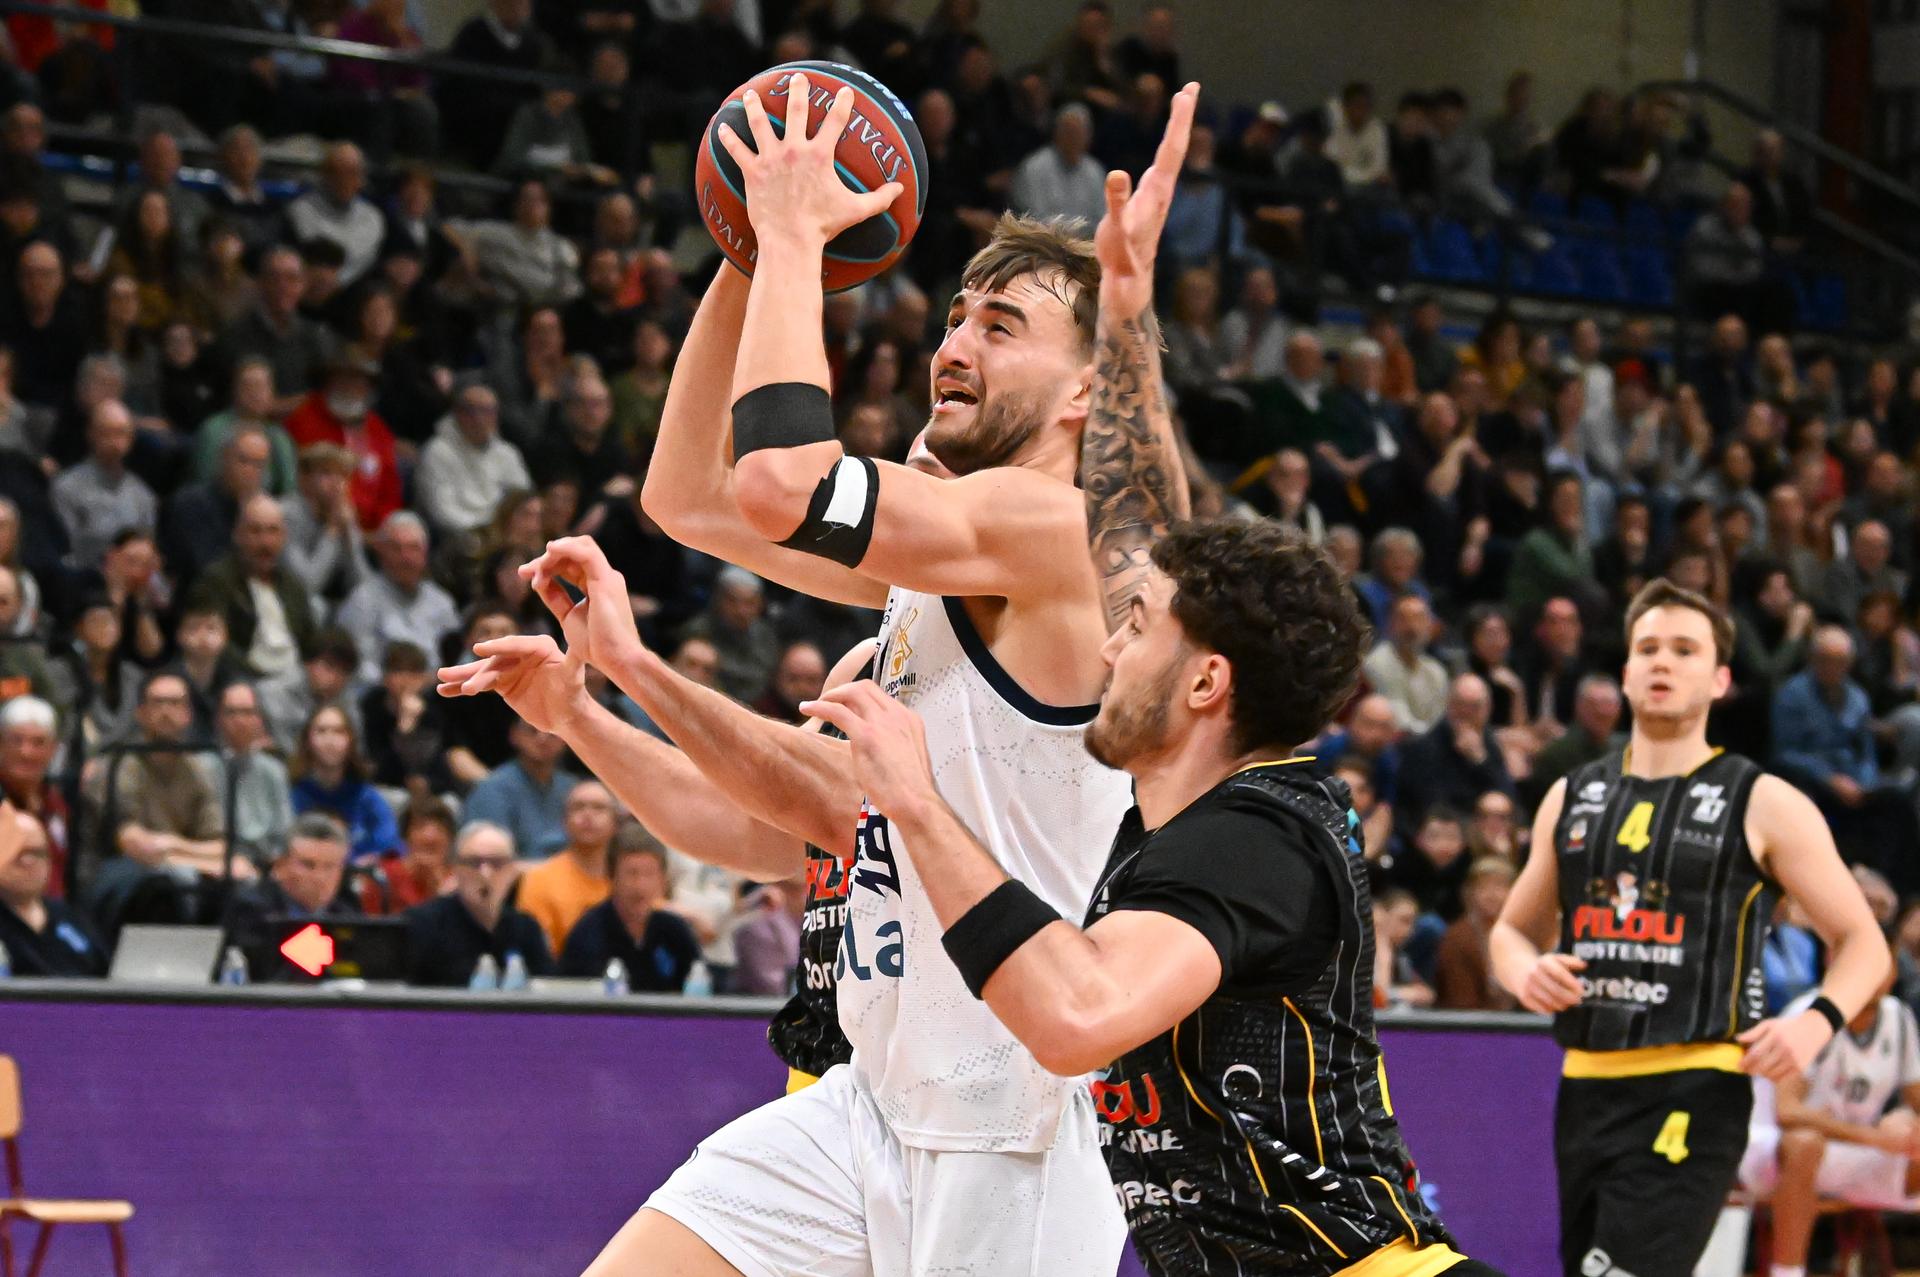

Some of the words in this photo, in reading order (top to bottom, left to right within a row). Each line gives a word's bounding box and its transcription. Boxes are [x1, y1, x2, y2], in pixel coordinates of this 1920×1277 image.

[1616, 801, 1655, 853] 4
[1578, 976, 1669, 1004] oretec
[1653, 1110, 1691, 1164] 4
